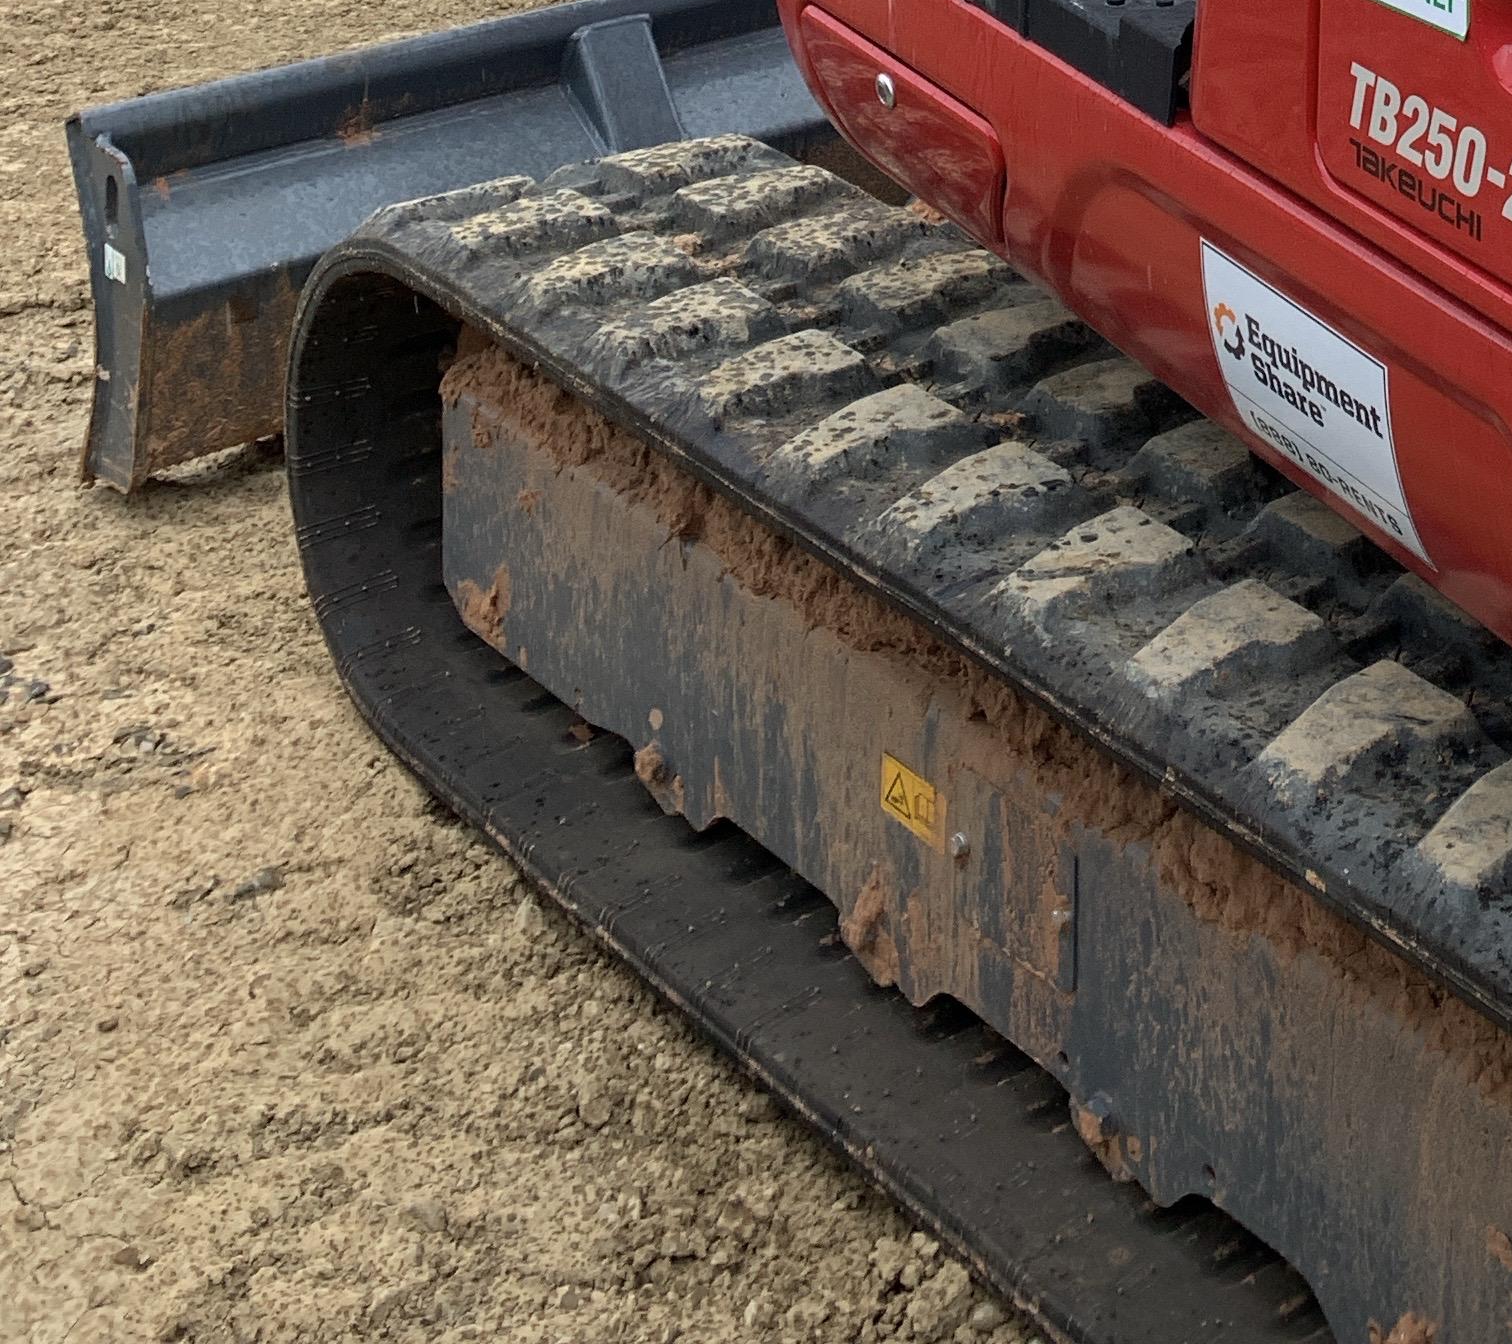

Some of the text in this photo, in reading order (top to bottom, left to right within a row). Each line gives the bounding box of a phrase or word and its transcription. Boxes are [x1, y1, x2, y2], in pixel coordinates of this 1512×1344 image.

[1244, 312, 1384, 440] Equipment
[1250, 352, 1325, 428] Share
[1249, 410, 1404, 536] (888) 80-RENTS
